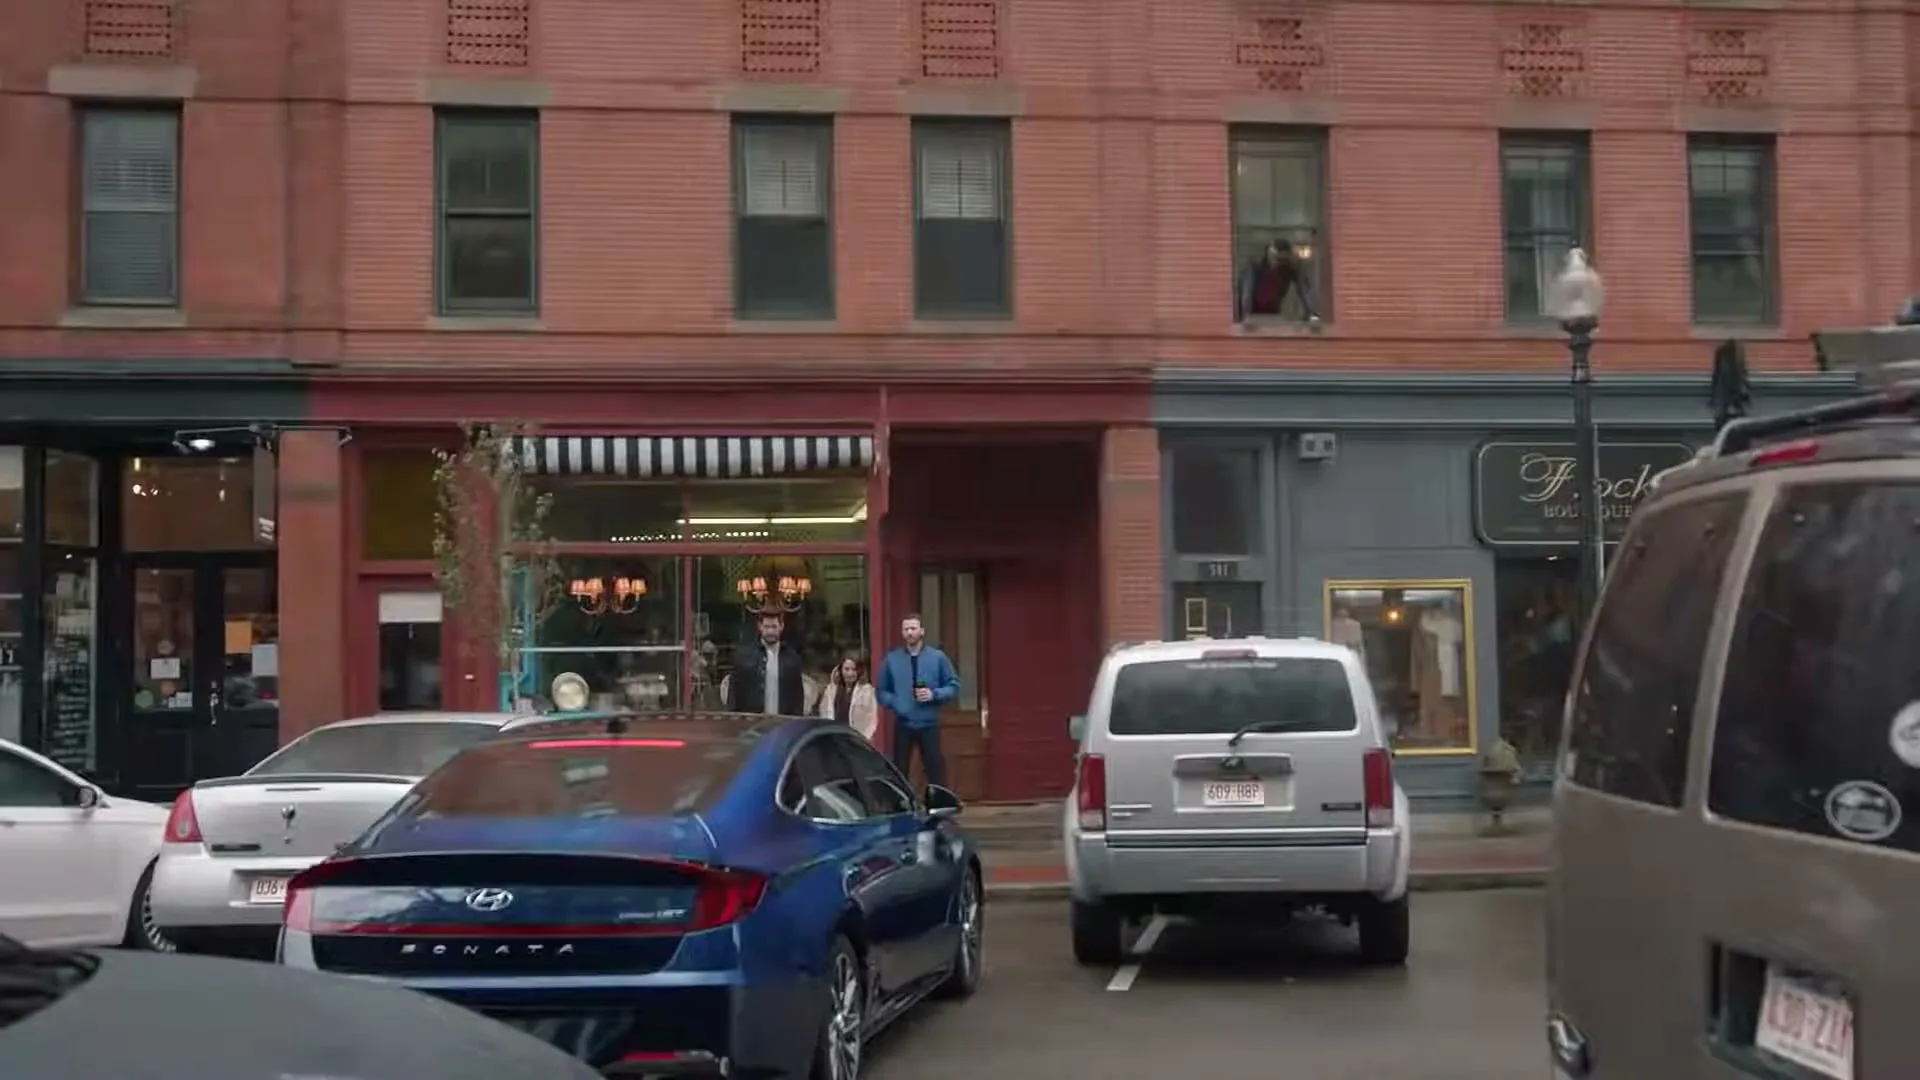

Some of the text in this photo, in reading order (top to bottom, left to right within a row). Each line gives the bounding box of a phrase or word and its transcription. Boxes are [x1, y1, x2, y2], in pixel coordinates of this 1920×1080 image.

[1519, 453, 1655, 502] Fock
[1544, 504, 1633, 519] BOUQUE
[401, 943, 574, 955] SONATA
